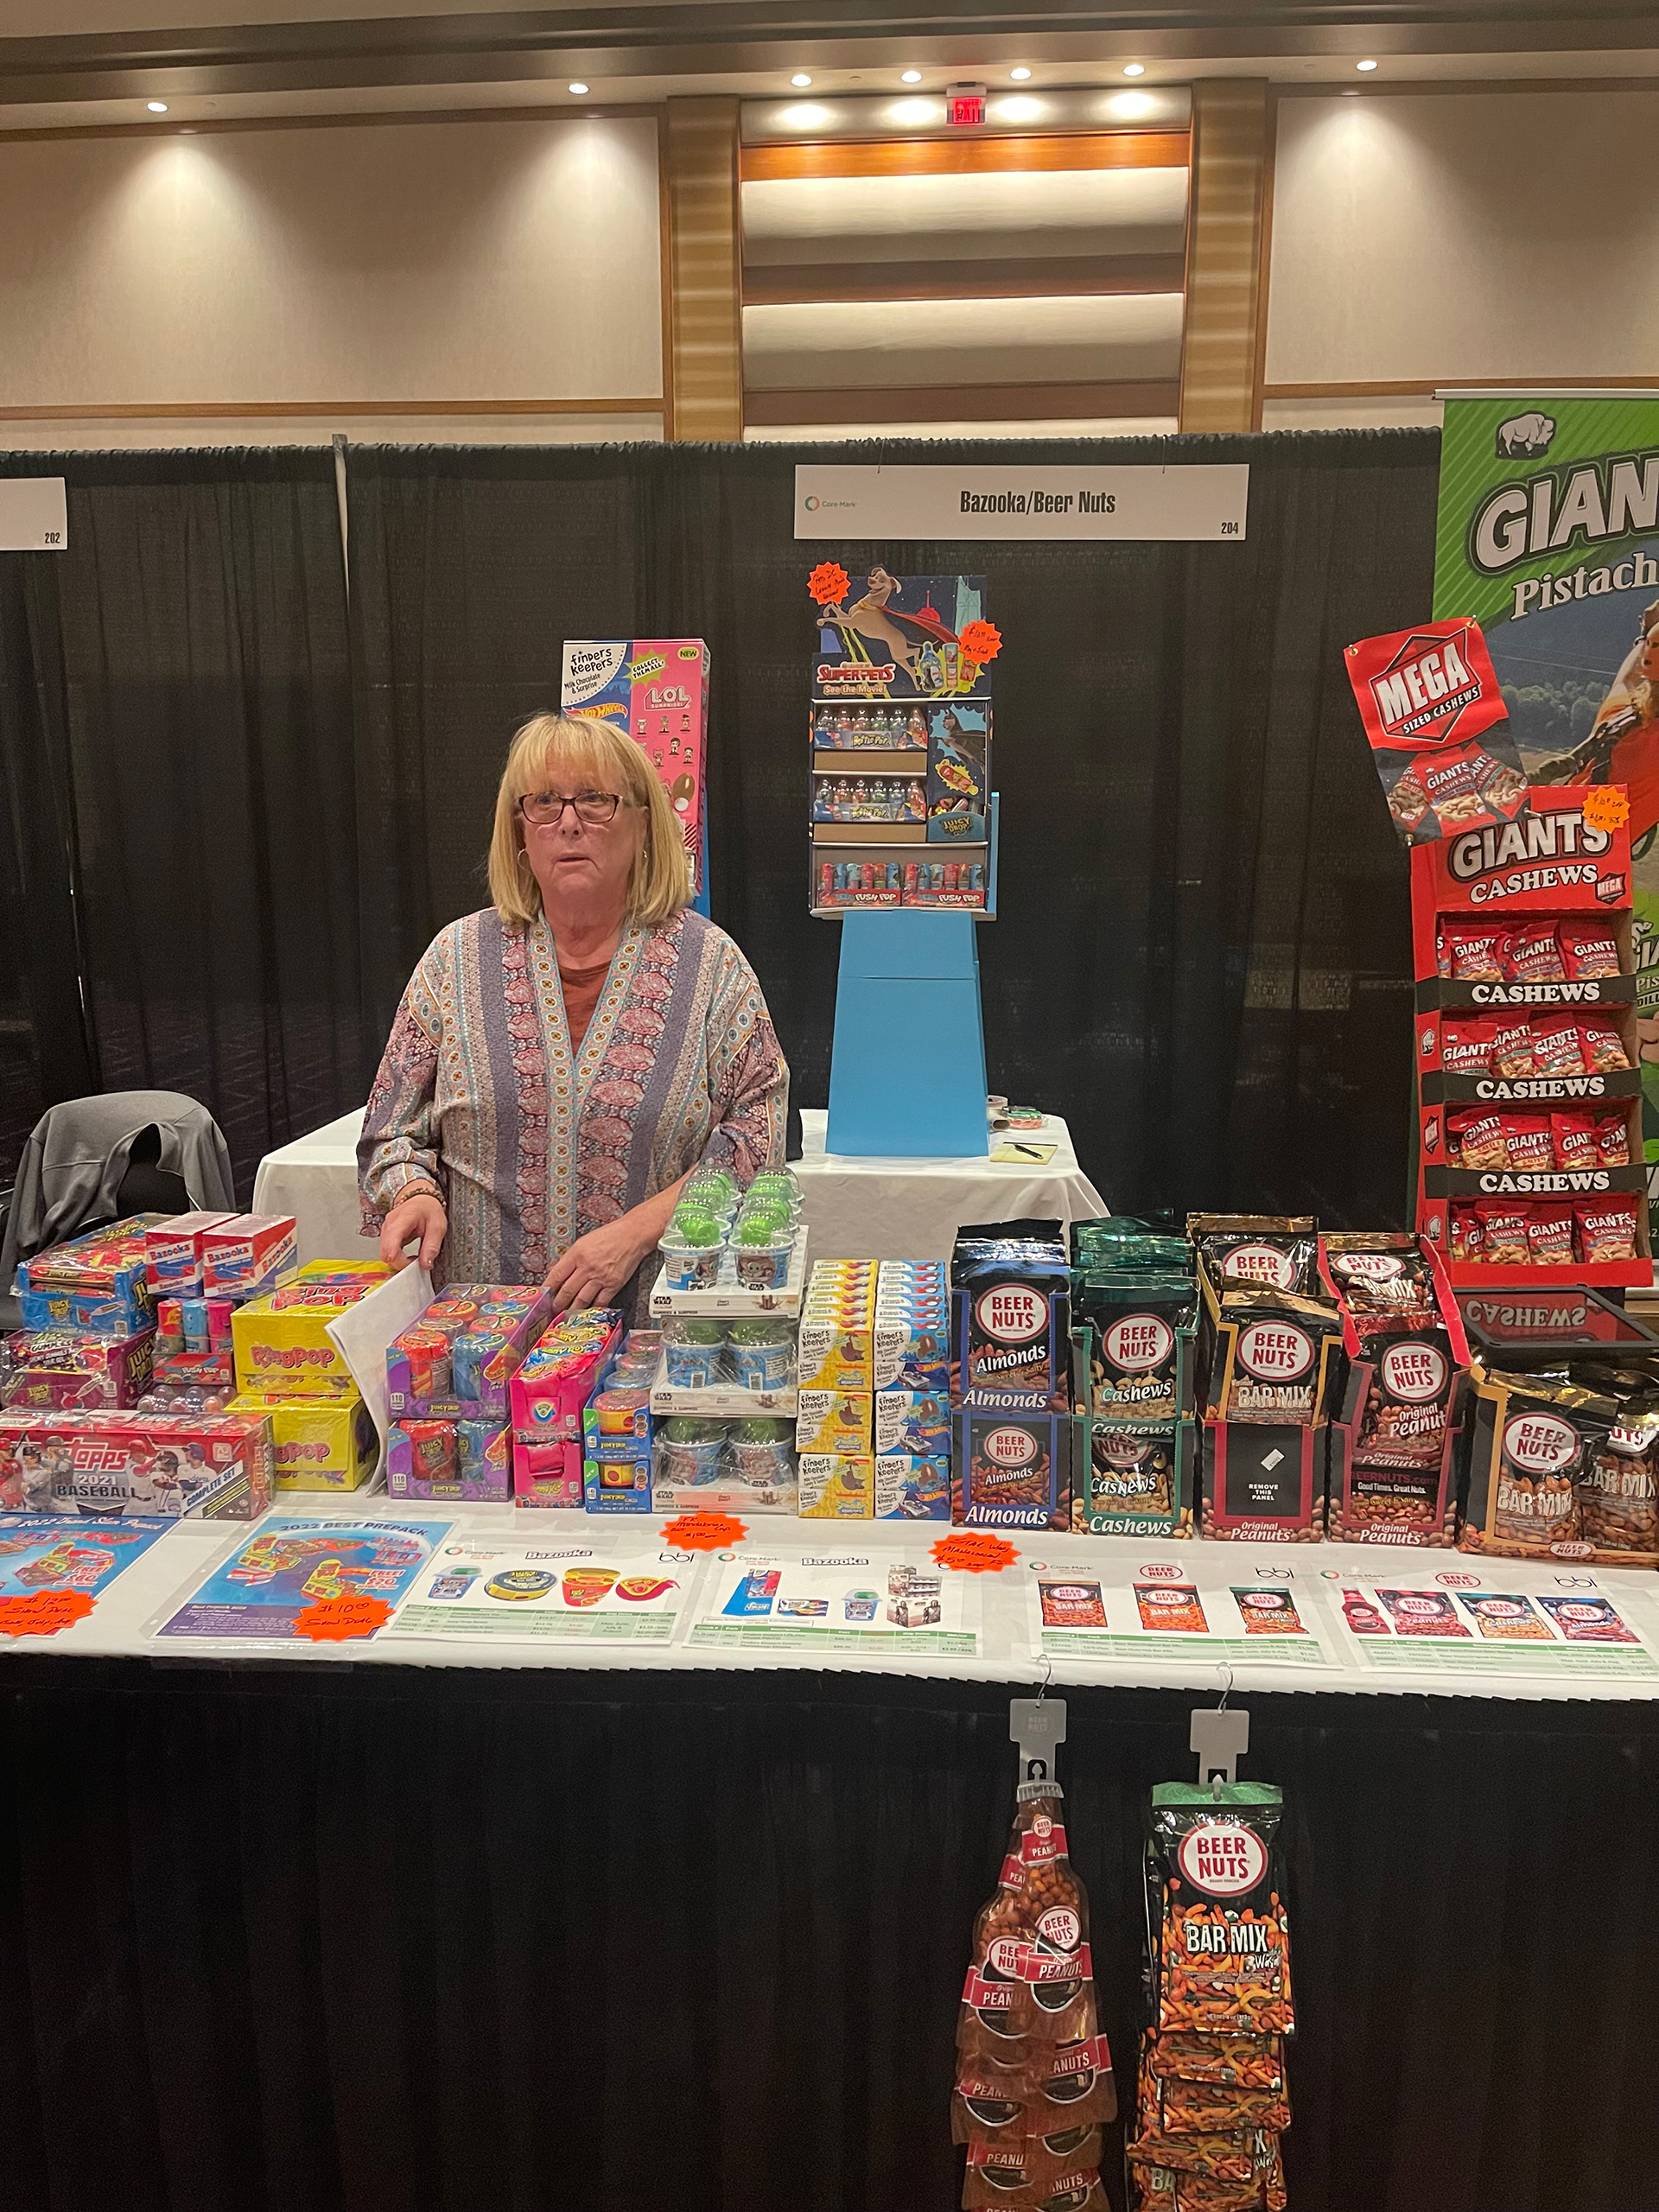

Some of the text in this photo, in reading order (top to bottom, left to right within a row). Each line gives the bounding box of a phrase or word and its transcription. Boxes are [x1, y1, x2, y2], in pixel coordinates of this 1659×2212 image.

[960, 491, 1116, 514] Bazooka/Beer Nuts
[1475, 457, 1659, 569] GIAN
[1221, 522, 1239, 535] 204
[44, 532, 60, 544] 202
[1511, 551, 1658, 621] Pistach
[632, 658, 658, 673] COLLECT
[825, 684, 887, 694] See the Movie!
[1376, 643, 1471, 726] MEGA
[650, 687, 690, 703] LOL
[1402, 686, 1479, 734] SIZED CASHEWS
[1427, 761, 1469, 790] GIANTS
[944, 818, 970, 830] JUICY
[1452, 812, 1609, 879] GIANTS
[1470, 864, 1599, 904] CASHEWS
[1472, 982, 1600, 1003] CASHEWS
[1477, 1077, 1605, 1099] CASHEWS
[1479, 1171, 1610, 1192] CASHEWS
[1585, 1212, 1631, 1230] GIANTS
[149, 1243, 191, 1261] Bazooka
[207, 1245, 249, 1263] Bazooka
[262, 1236, 293, 1274] Bazooka
[1346, 1254, 1389, 1266] BEER
[1236, 1255, 1279, 1270] BEER
[1350, 1262, 1392, 1272] NUTS
[271, 1293, 364, 1311] Pop
[992, 1296, 1033, 1310] BEER
[992, 1312, 1035, 1329] NUTS
[1120, 1325, 1157, 1341] BEER
[1255, 1332, 1297, 1351] BEER
[1119, 1341, 1158, 1360] NUTS
[976, 1345, 1046, 1374] Almonds
[1252, 1349, 1296, 1370] NUTS
[1390, 1353, 1432, 1370] BEER
[1394, 1370, 1434, 1389] NUTS
[963, 1389, 1047, 1408] Almonds
[1101, 1382, 1172, 1403] Cashews
[1238, 1385, 1312, 1408] BAR MIX
[586, 1415, 595, 1426] NEW
[1399, 1402, 1439, 1422] Original
[1091, 1423, 1174, 1435] Cashews
[1389, 1412, 1446, 1438] Peanut
[1520, 1422, 1567, 1444] BEER
[996, 1435, 1025, 1446] BEER
[1098, 1440, 1139, 1456] NUTS
[996, 1446, 1026, 1457] NUTS
[1374, 1452, 1413, 1461] Original
[1516, 1439, 1562, 1462] NUTS
[1361, 1455, 1424, 1468] Peanuts
[78, 1474, 117, 1485] 2021
[586, 1468, 595, 1478] NEW
[985, 1467, 1033, 1485] Almonds
[57, 1484, 138, 1497] BASEBALL
[187, 1476, 222, 1506] COMPLETE
[223, 1467, 235, 1483] SET
[1091, 1476, 1157, 1497] Cashews
[1357, 1482, 1427, 1494] Good Times. Great Nuts.
[1621, 1472, 1656, 1498] MIX
[1497, 1484, 1573, 1516] BAR MIX
[964, 1505, 1048, 1526] Almonds
[280, 1522, 319, 1532] 2022
[364, 1522, 428, 1536] PREPACK
[1089, 1516, 1173, 1536] Cashews
[1241, 1521, 1279, 1531] Original
[1370, 1522, 1409, 1534] Original
[1230, 1529, 1292, 1542] Peanuts
[1359, 1529, 1422, 1546] Peanuts
[524, 1548, 593, 1560] Bazooka
[801, 1557, 869, 1566] Bazooka
[1250, 1611, 1272, 1620] BAR
[1407, 1604, 1435, 1612] NUTS
[1567, 1605, 1595, 1614] BEER
[1571, 1611, 1599, 1619] NUTS
[1570, 1620, 1612, 1629] Almonds
[1197, 1837, 1247, 1854] BEER
[1198, 1858, 1249, 1879] NUTS
[1044, 1915, 1071, 1931] BEER
[1046, 1926, 1074, 1943] NUTS
[1186, 1923, 1268, 1953] BAR MIX
